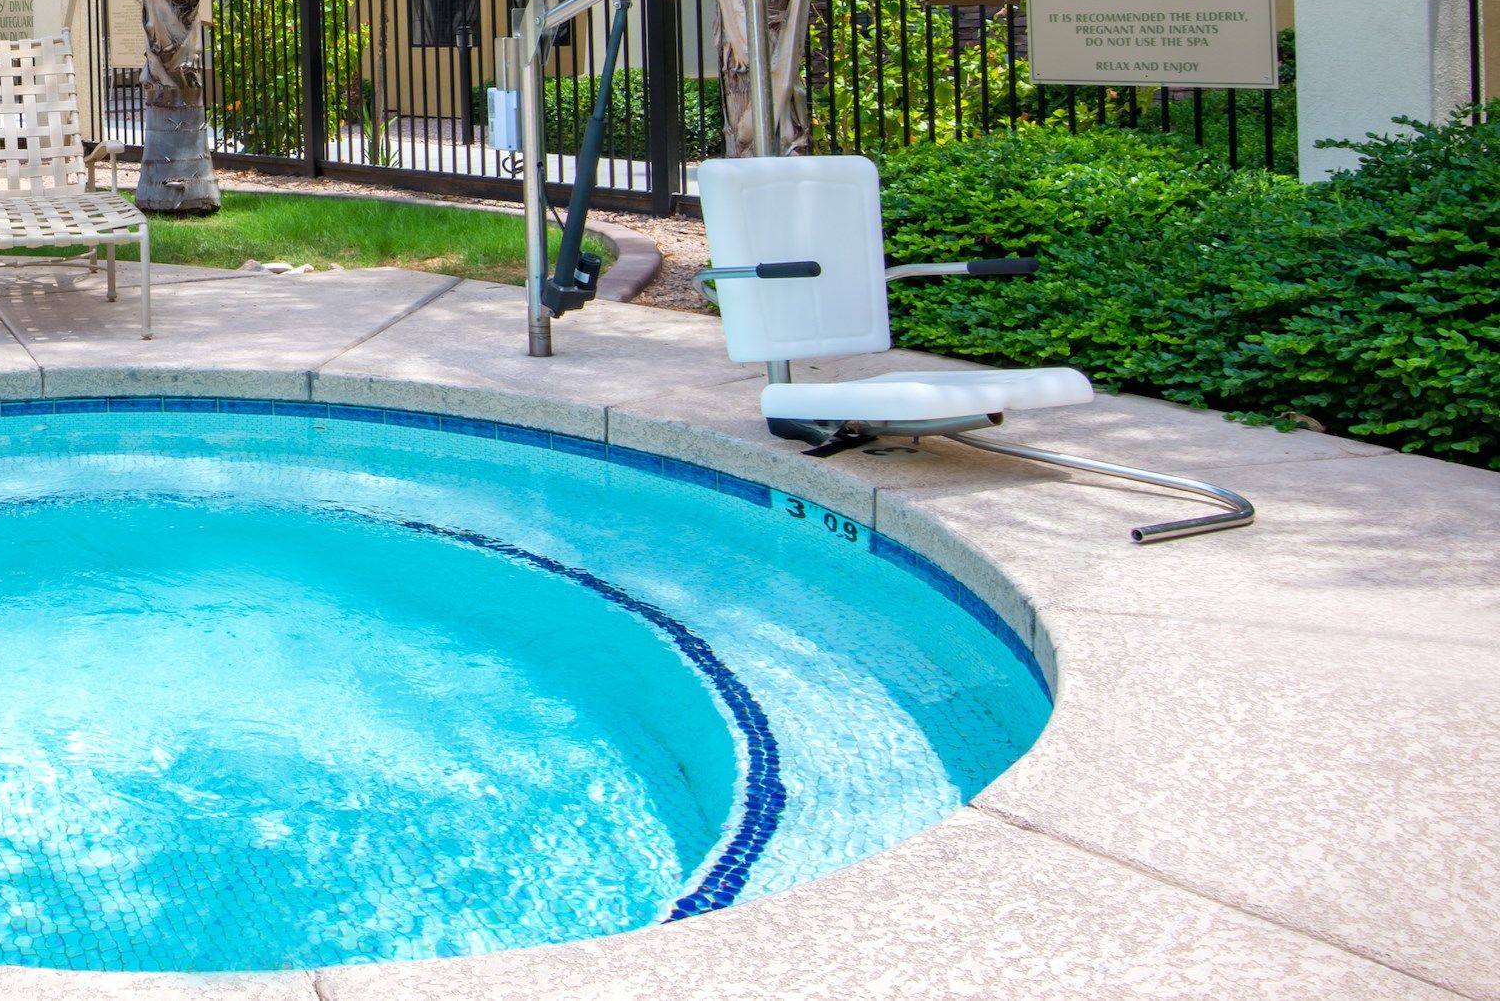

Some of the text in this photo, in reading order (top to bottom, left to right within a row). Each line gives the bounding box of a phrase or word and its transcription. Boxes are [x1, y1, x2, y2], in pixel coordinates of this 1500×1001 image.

[1049, 12, 1248, 22] IT IS RECOMMENDED THE ELDERLY,
[1076, 25, 1218, 34] PREGNANT AND INFANTS
[1085, 38, 1209, 46] DO NOT USE THE SPA
[1096, 62, 1199, 73] RELAX AND ENJOY
[786, 498, 806, 518] 3
